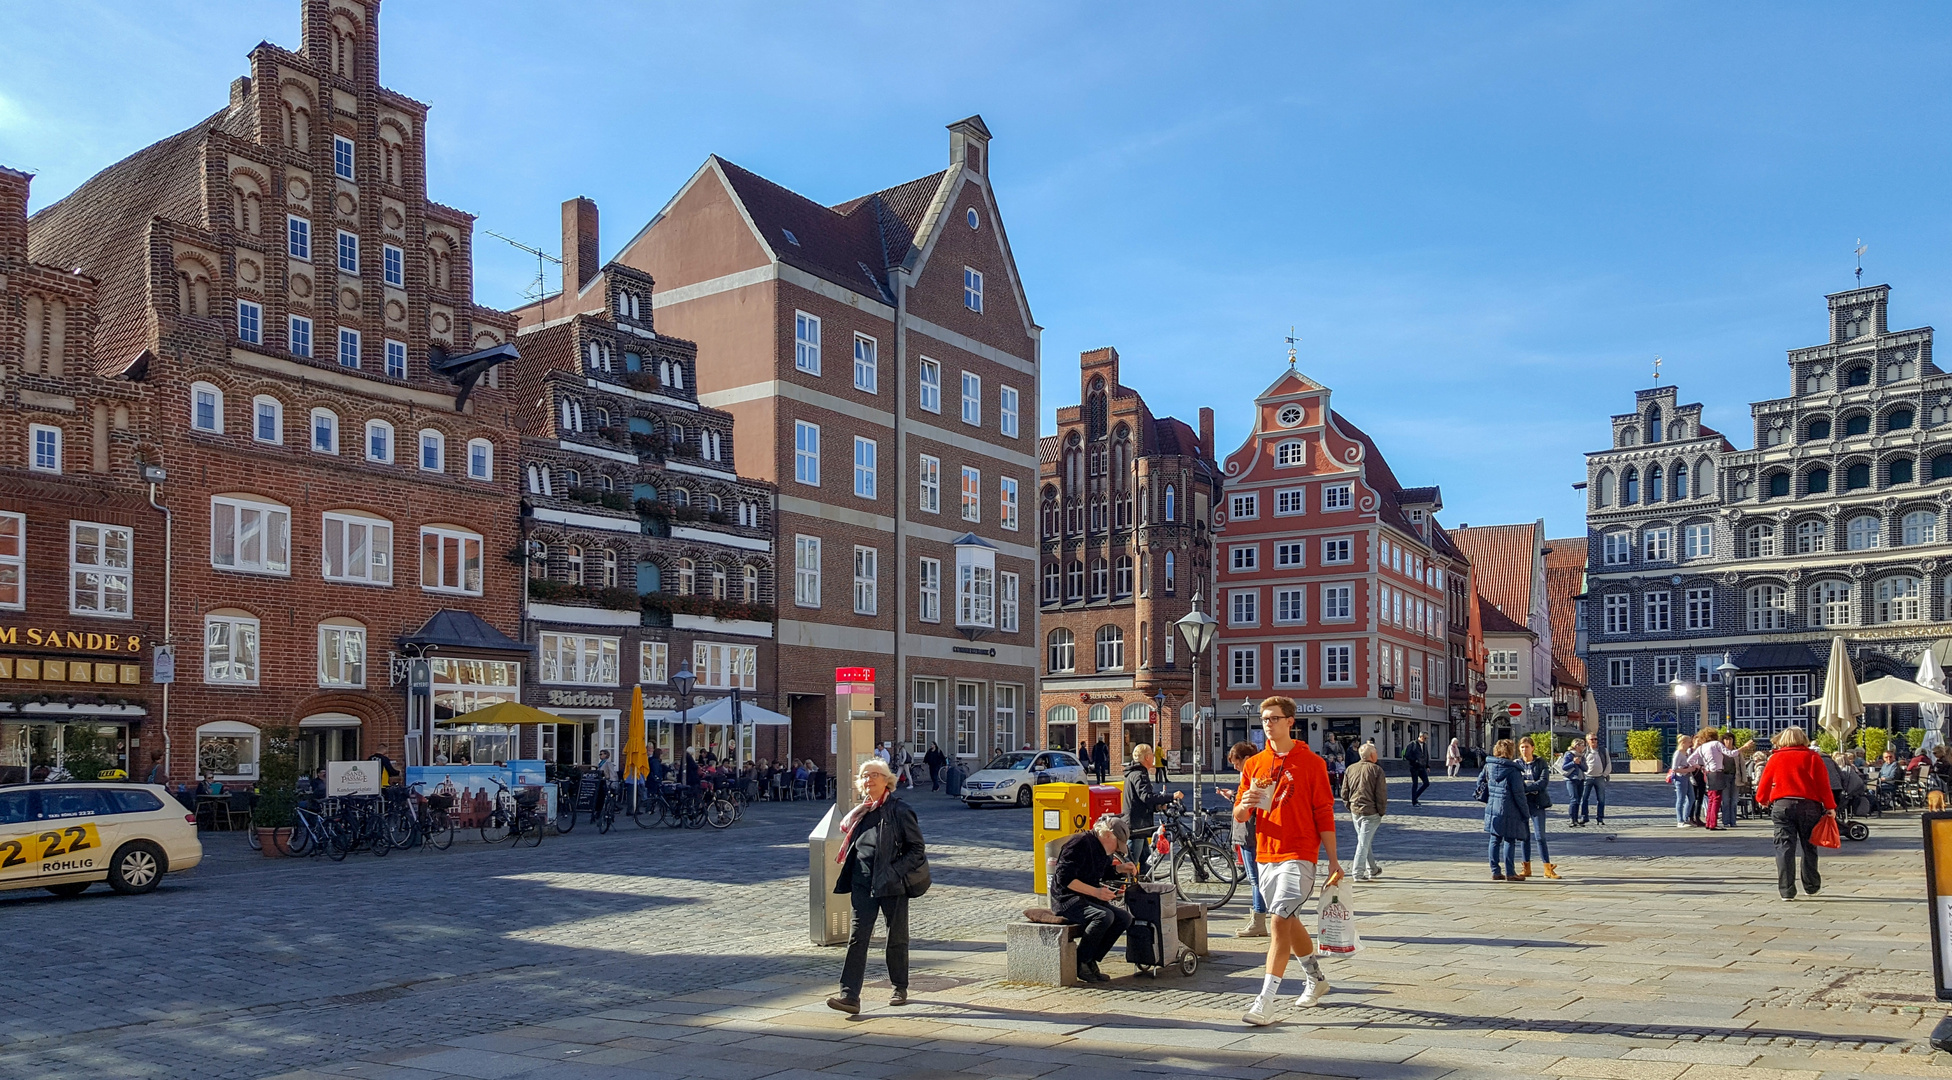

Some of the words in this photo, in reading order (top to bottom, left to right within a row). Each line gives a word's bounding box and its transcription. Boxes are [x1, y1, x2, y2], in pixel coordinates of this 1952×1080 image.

[27, 628, 120, 651] SANDE
[127, 635, 141, 652] 8
[548, 690, 614, 707] Bäckerei
[39, 826, 91, 858] 22
[43, 859, 93, 872] RÖHLIG
